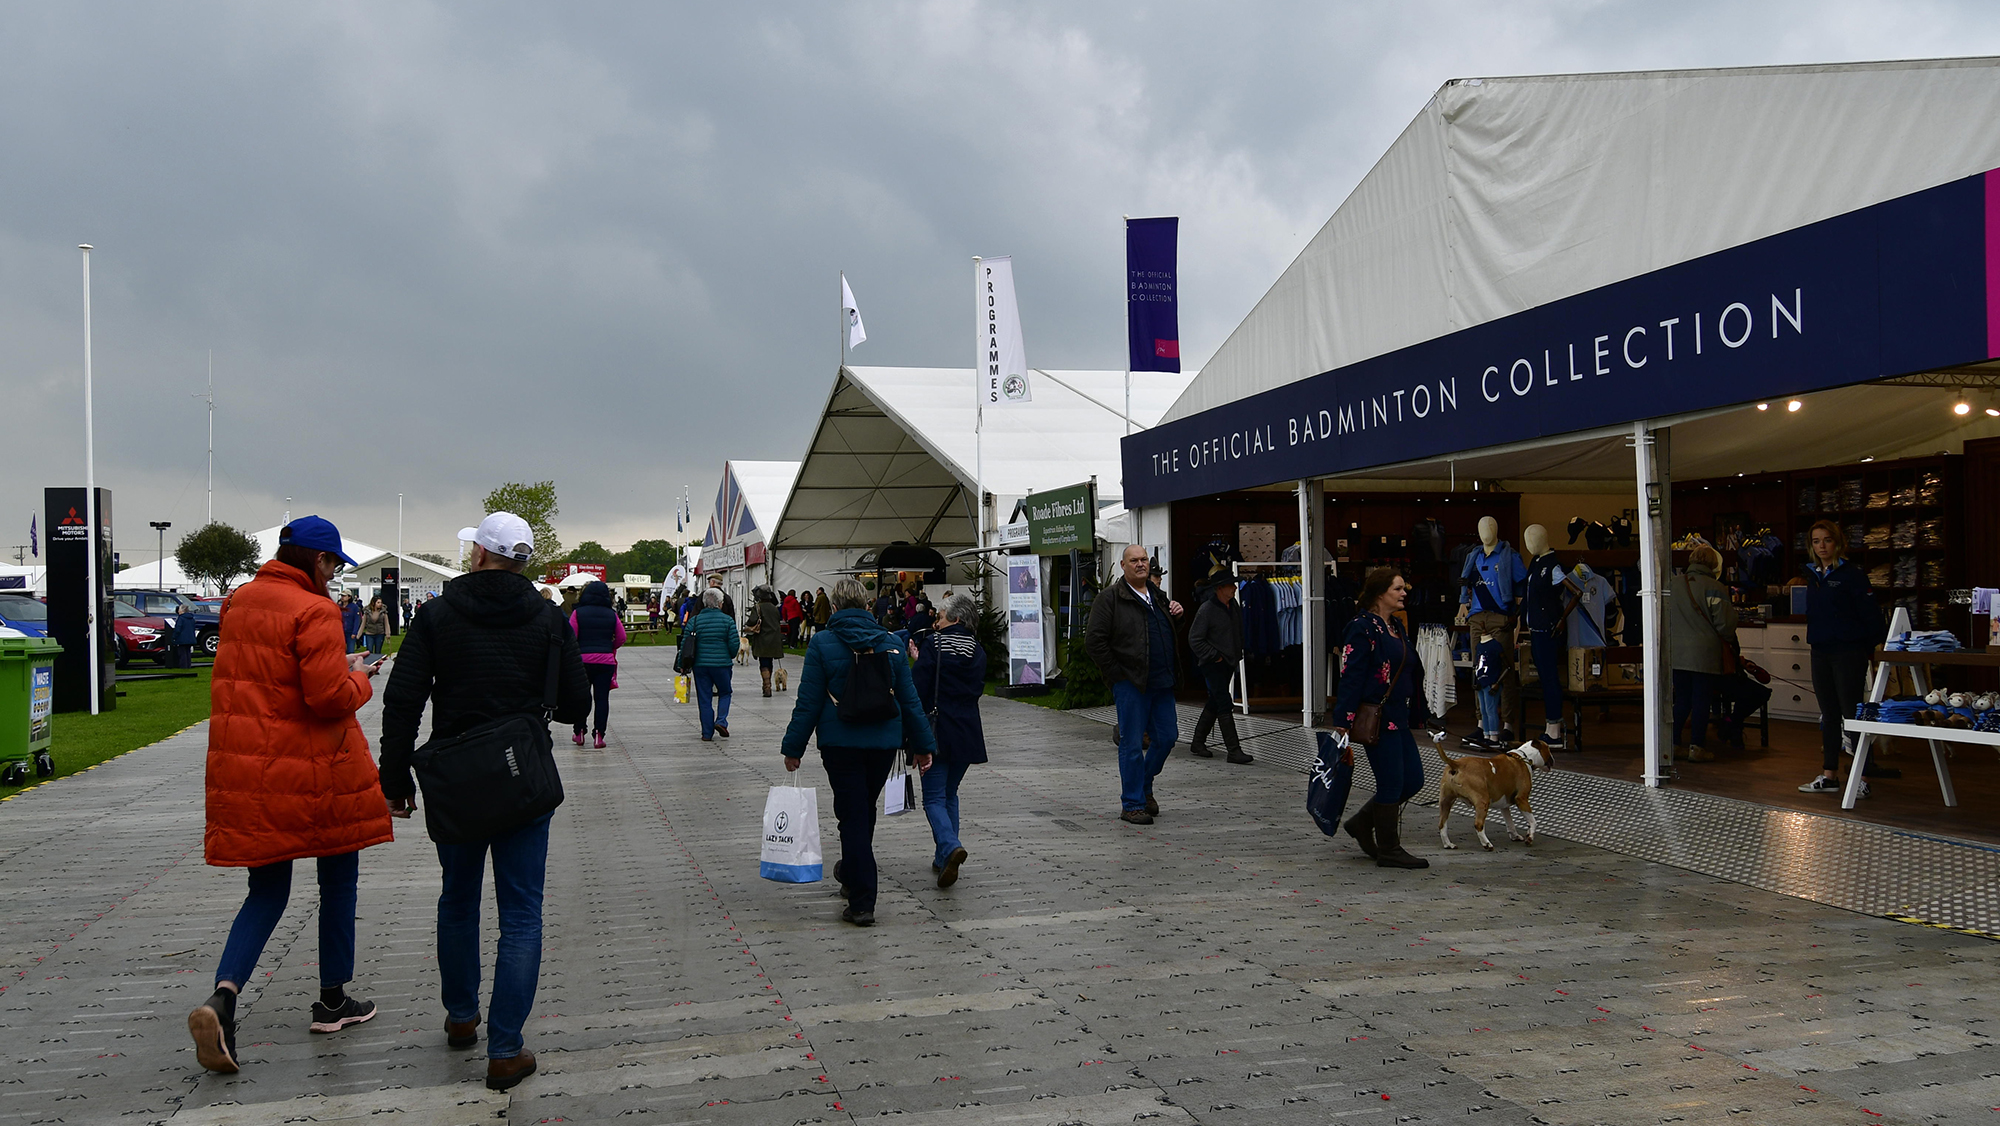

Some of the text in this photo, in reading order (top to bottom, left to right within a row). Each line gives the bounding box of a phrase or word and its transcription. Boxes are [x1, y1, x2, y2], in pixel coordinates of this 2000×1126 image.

[1147, 271, 1172, 279] OFFICIAL
[1131, 282, 1172, 291] BADMINTON
[1131, 293, 1172, 303] COLLECTION
[986, 267, 999, 403] PROGRAMMES
[1152, 287, 1802, 476] THE OFFICIAL BADMINTON COLLECTION
[1032, 496, 1086, 521] Roade Fibres Ltd
[1007, 526, 1029, 539] PROGRAMME
[36, 672, 50, 686] WASTE
[505, 746, 520, 777] THULE
[766, 834, 778, 842] LAZY
[778, 835, 794, 844] JACKS
